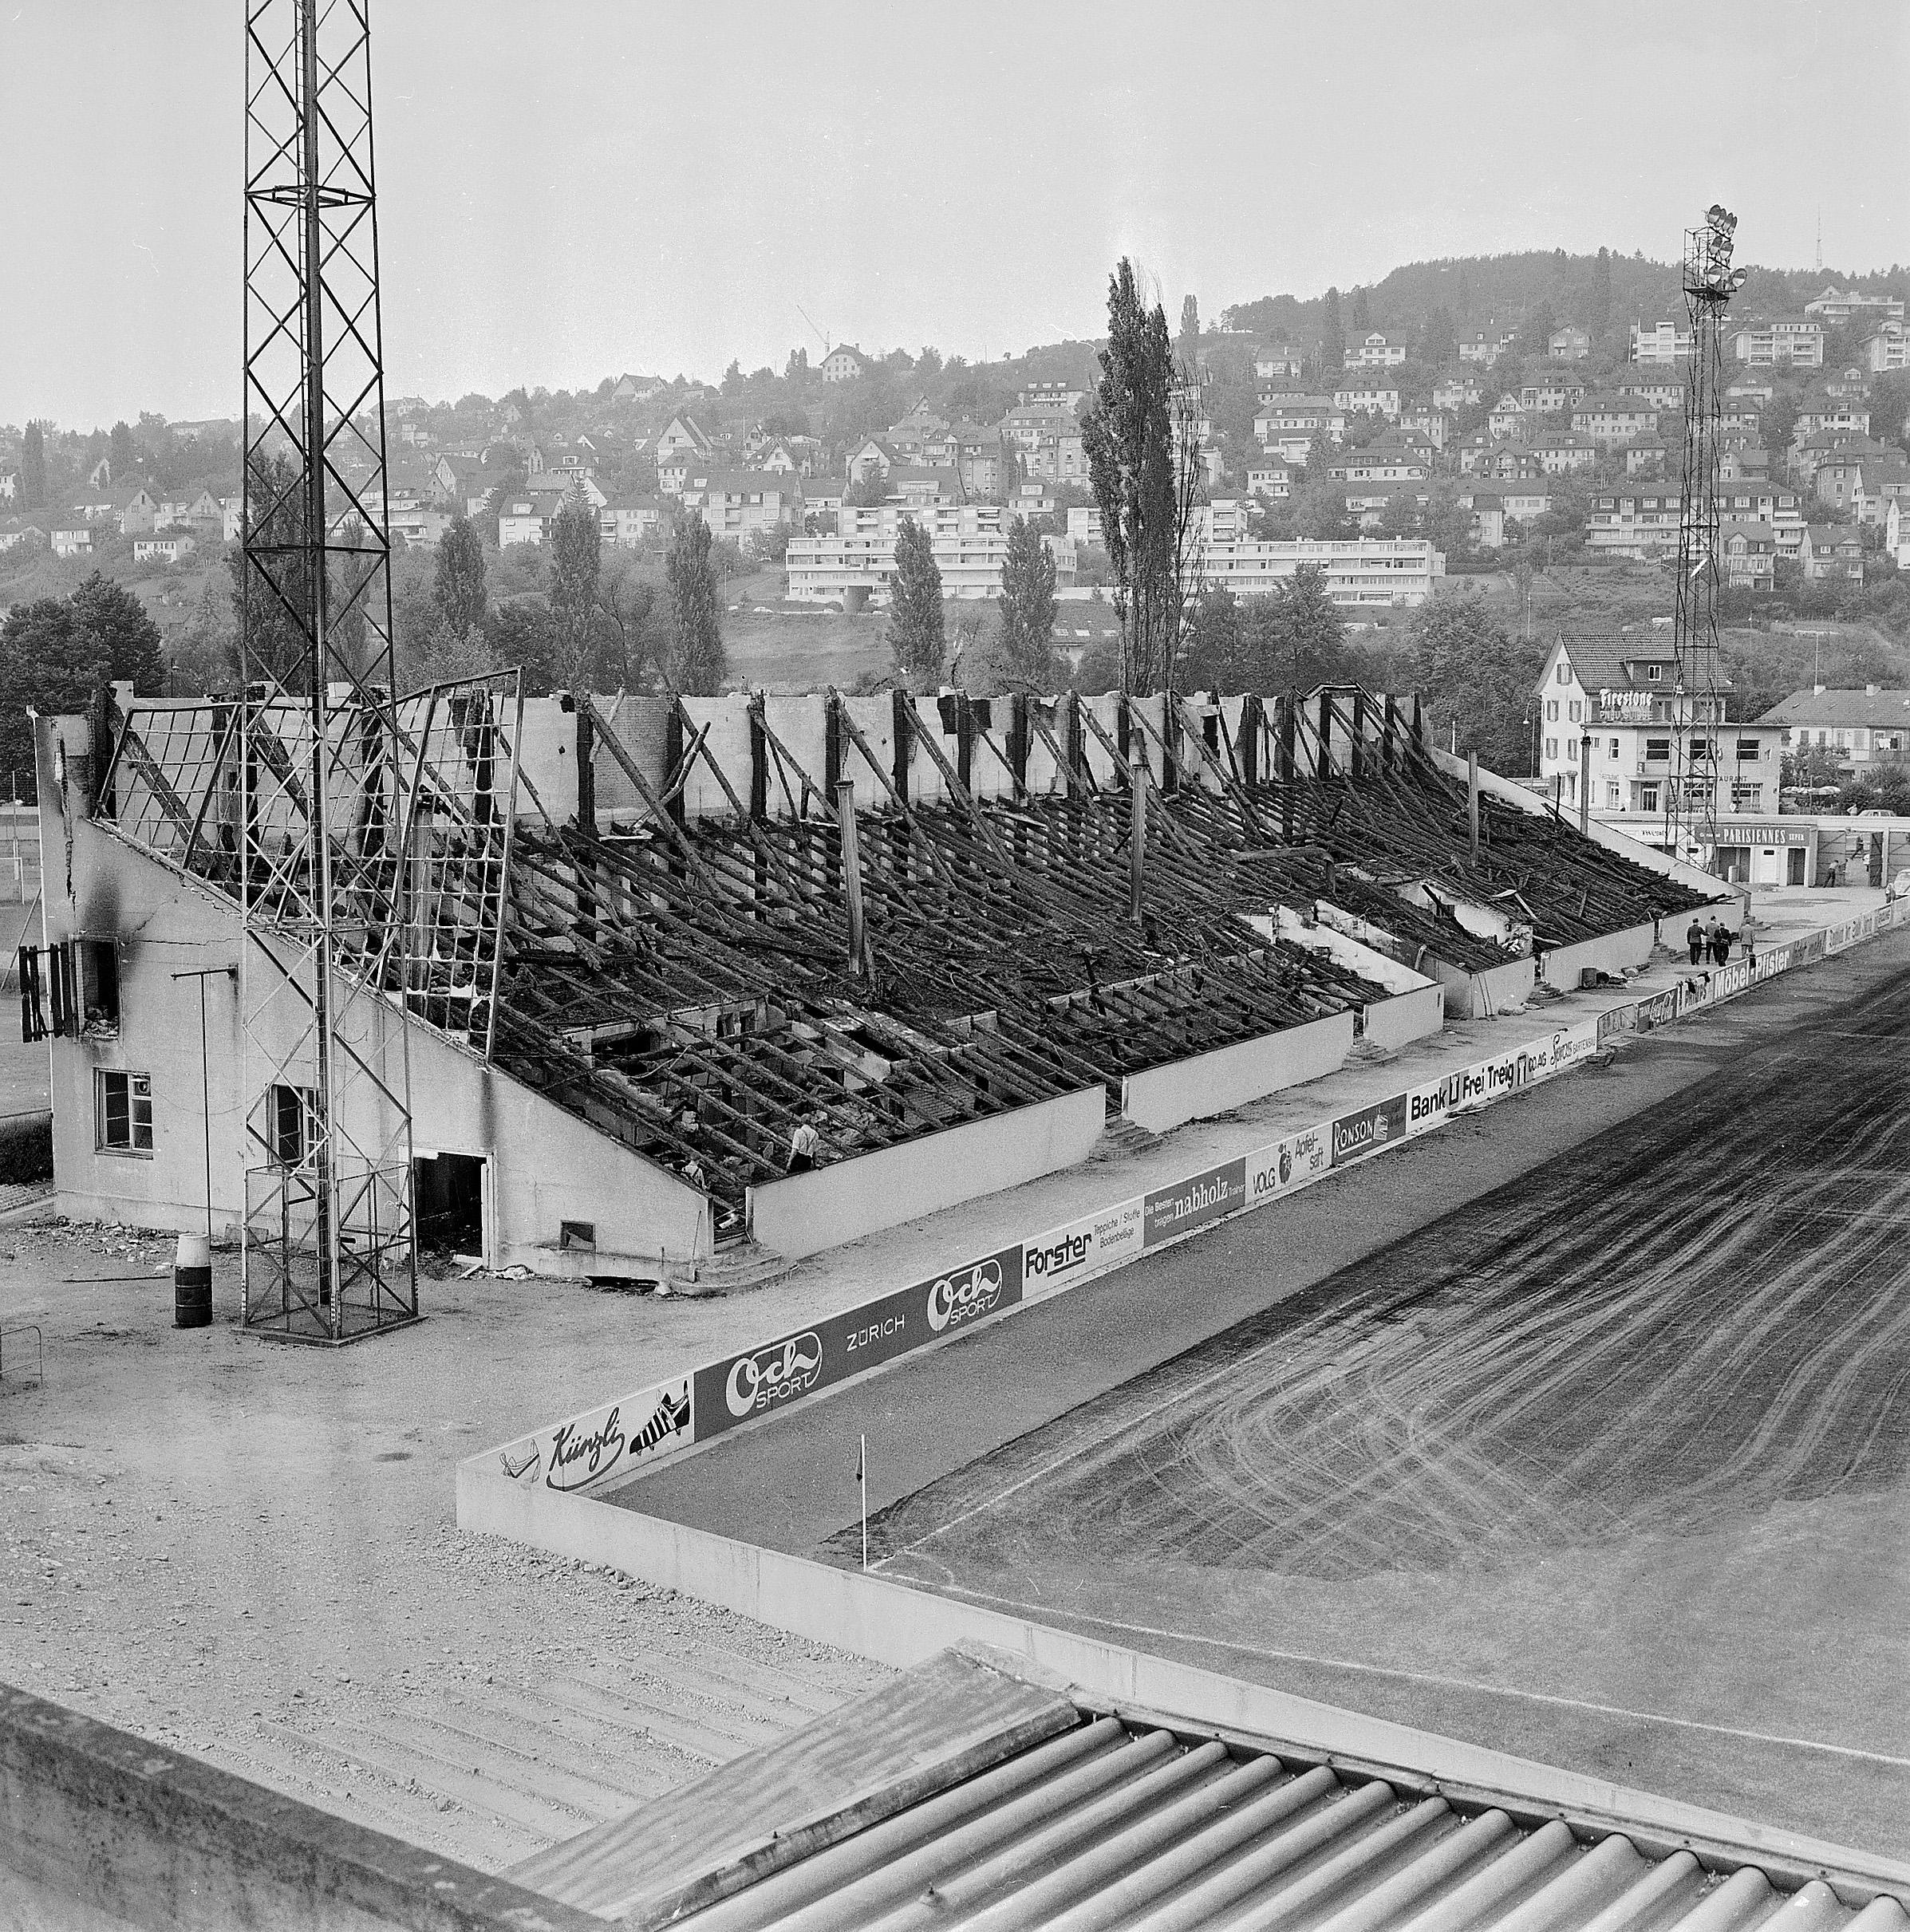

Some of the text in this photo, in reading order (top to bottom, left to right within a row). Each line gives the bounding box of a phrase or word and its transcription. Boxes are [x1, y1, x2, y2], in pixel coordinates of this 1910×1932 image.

[1600, 688, 1654, 709] Firestone
[1723, 827, 1786, 845] PARISIENNES
[1714, 949, 1790, 999] Möbel-Pfister
[1411, 1087, 1448, 1122] Bank
[1487, 1059, 1514, 1090] Treig
[1334, 1120, 1373, 1157] RONSON
[1174, 1176, 1229, 1220] nabholz
[1253, 1167, 1276, 1194] VOLG
[1144, 1205, 1154, 1217] Die
[1025, 1232, 1092, 1279] Forster
[927, 1259, 1003, 1332] Och
[950, 1296, 992, 1326] SPORT
[846, 1314, 906, 1353] ZÜRICH
[725, 1331, 823, 1417] Och
[756, 1372, 812, 1410] SPORT
